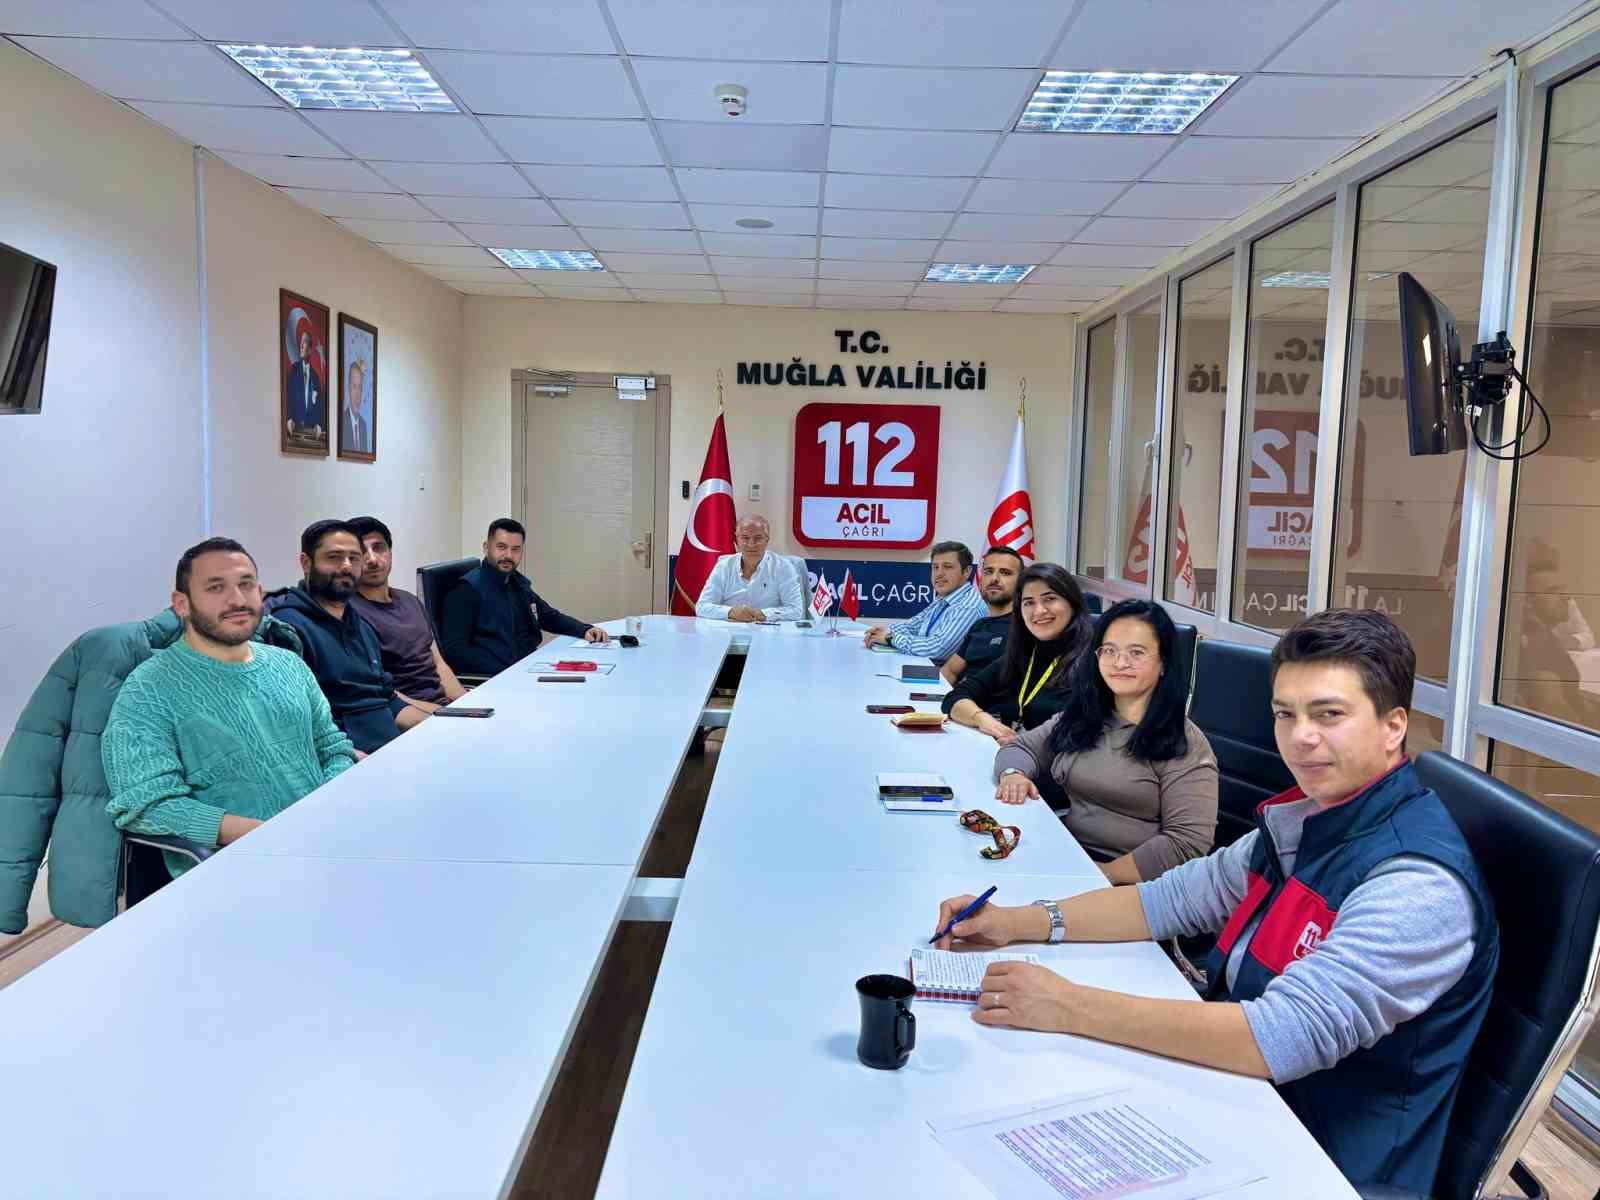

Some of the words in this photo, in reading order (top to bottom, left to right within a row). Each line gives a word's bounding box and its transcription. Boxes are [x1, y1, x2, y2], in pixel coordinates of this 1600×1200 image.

[835, 330, 889, 354] T.C.
[736, 356, 847, 387] MUĞLA
[856, 360, 987, 390] VALİLİĞİ
[817, 421, 916, 487] 112
[836, 502, 891, 524] ACİL
[842, 525, 884, 538] ÇAĞRI
